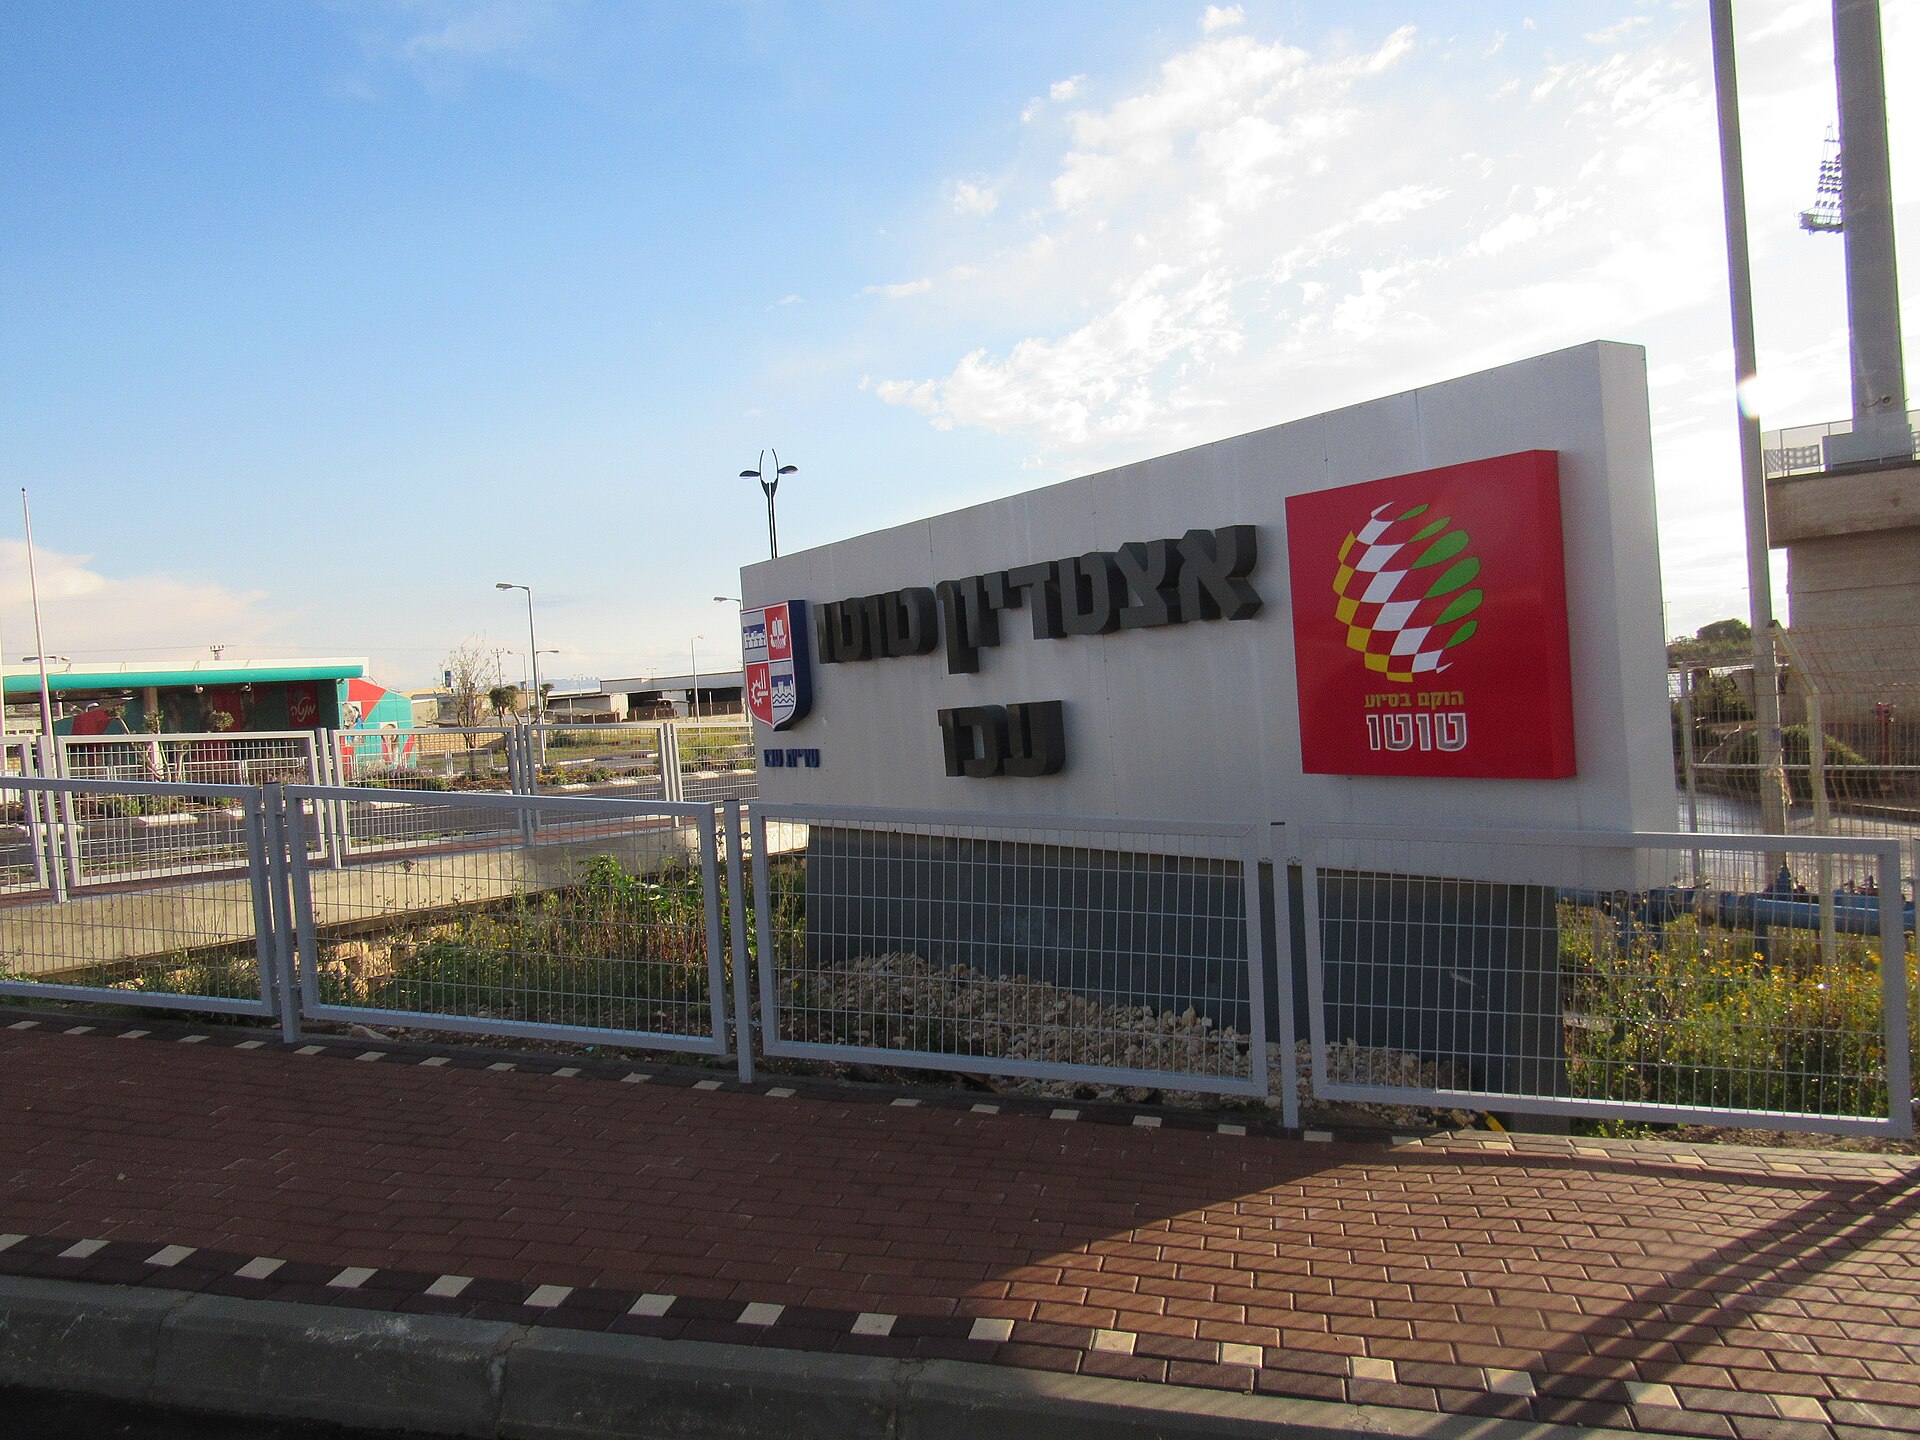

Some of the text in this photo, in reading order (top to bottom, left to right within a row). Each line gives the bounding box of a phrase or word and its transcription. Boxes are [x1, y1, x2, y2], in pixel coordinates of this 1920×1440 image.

[812, 524, 1260, 673] אצטדיון טוטו
[1364, 691, 1465, 710] הוקם בסיוע
[938, 700, 1066, 777] עכו
[1366, 713, 1468, 752] טוטו
